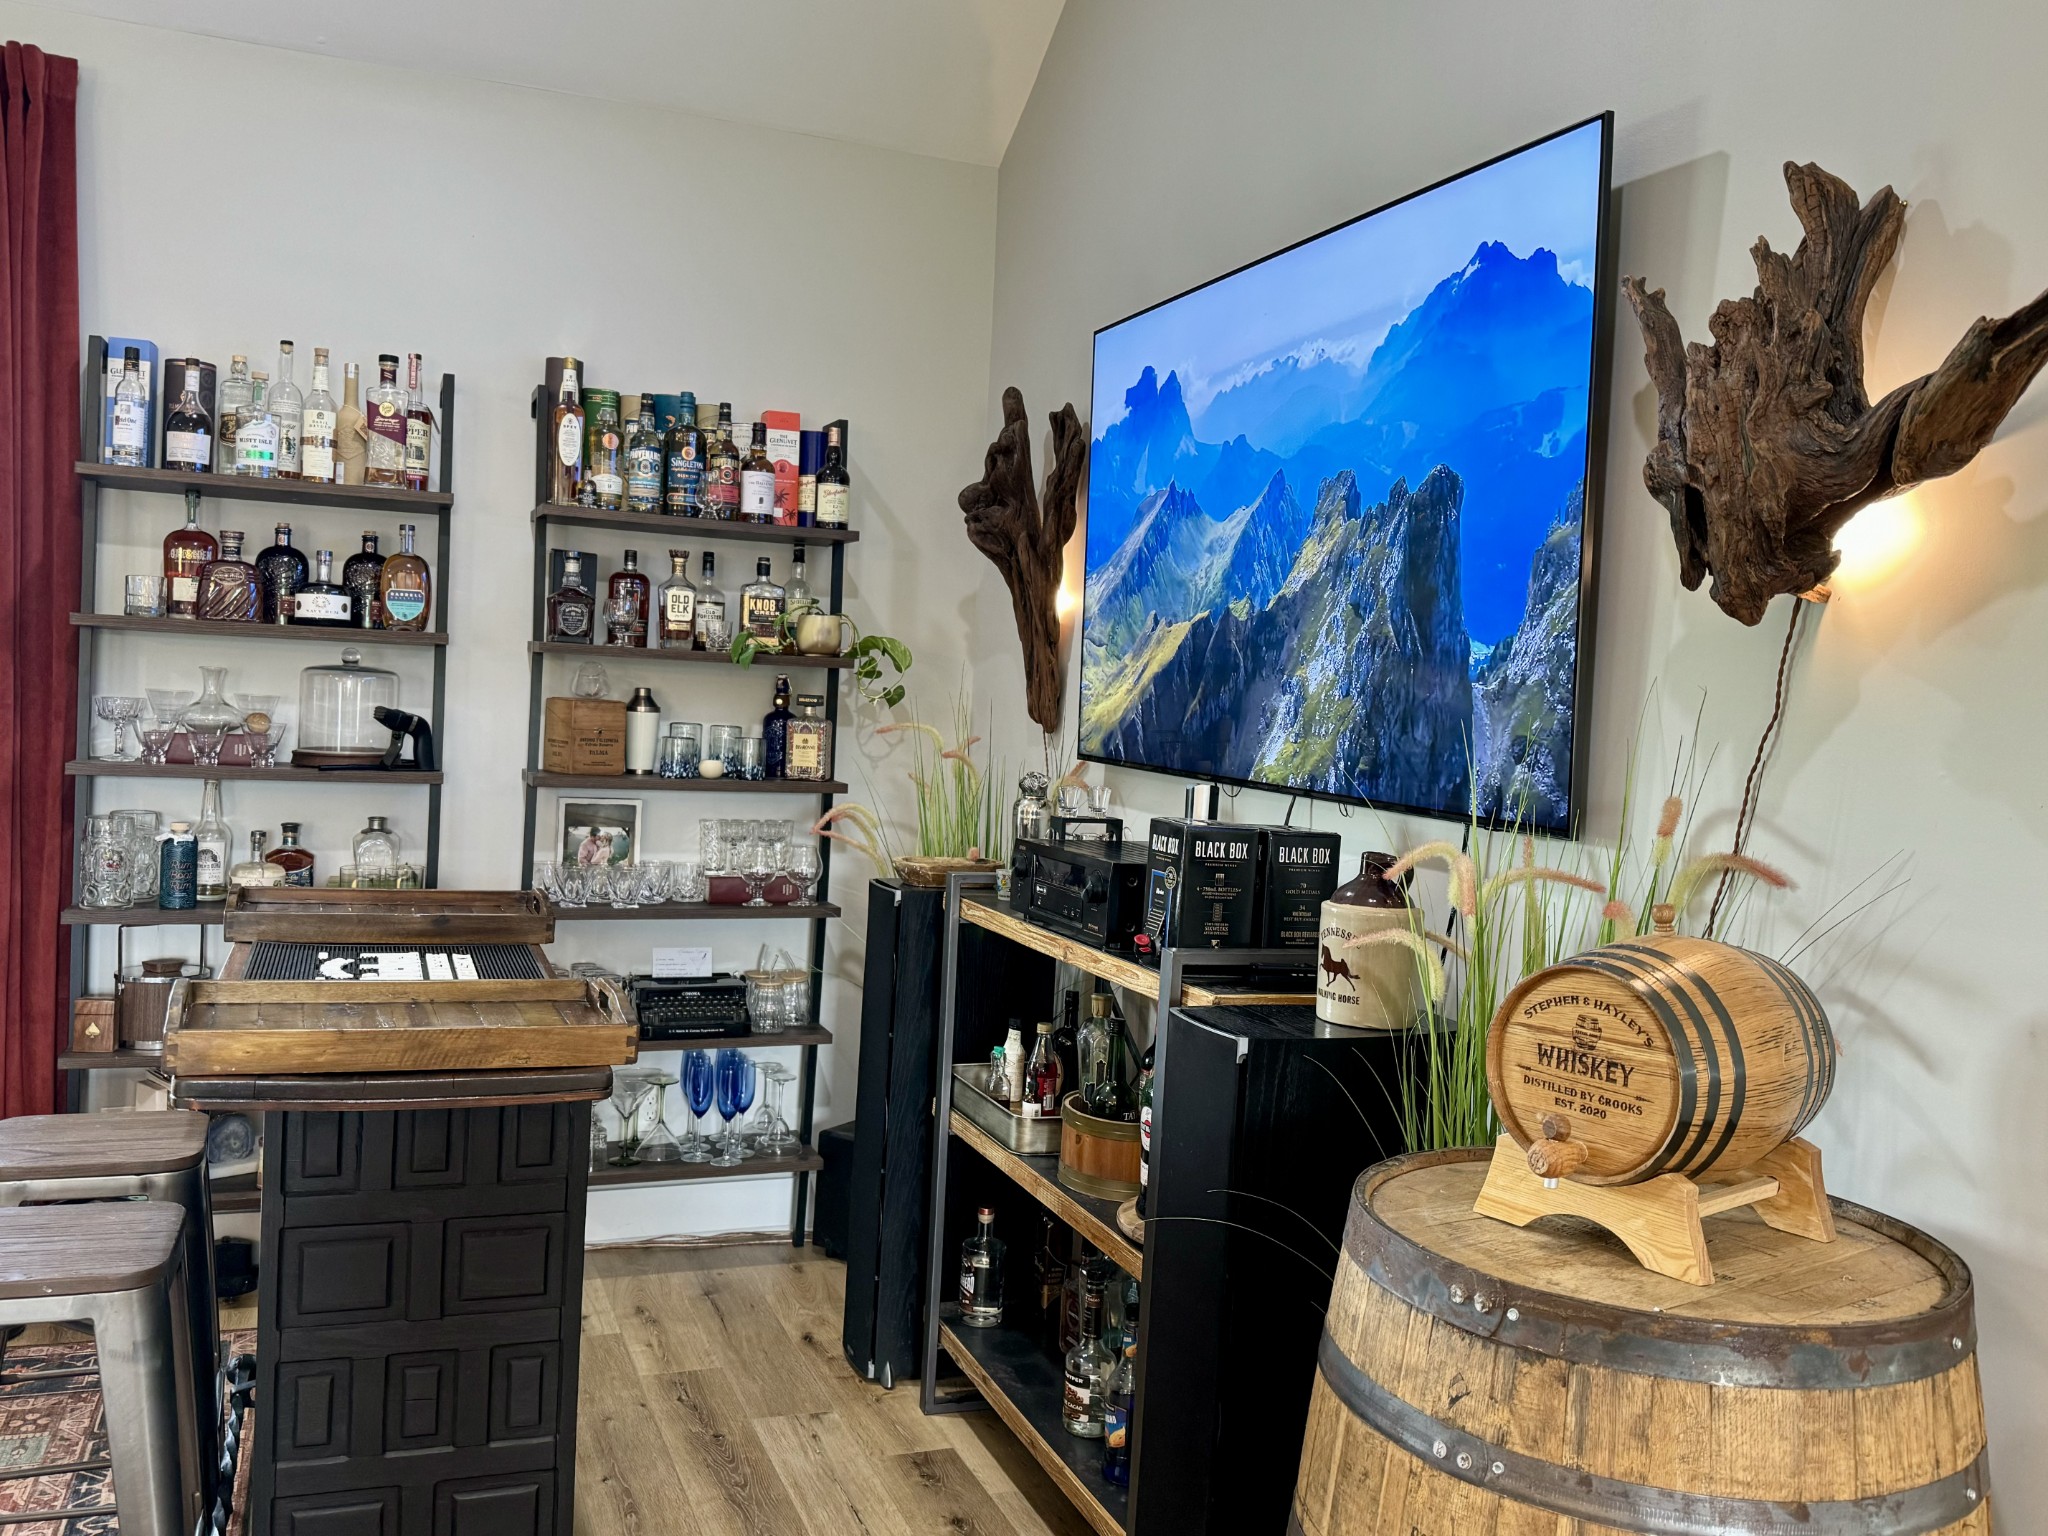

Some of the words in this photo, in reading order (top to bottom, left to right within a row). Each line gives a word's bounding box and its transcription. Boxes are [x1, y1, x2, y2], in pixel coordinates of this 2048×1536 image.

[769, 437, 798, 446] GLENLIVET
[671, 594, 690, 605] OLD
[750, 598, 776, 611] KNOB
[671, 604, 689, 614] ELK
[1152, 834, 1168, 853] BLACK
[1195, 841, 1225, 858] BLACK
[1230, 841, 1248, 859] BOX
[1279, 847, 1308, 863] BLACK
[1313, 848, 1330, 864] BOX
[171, 860, 192, 870] Rum
[170, 881, 192, 890] Rum
[1337, 993, 1360, 1006] HORSE
[1524, 995, 1580, 1019] STEPHEN
[1582, 995, 1590, 1006] &
[1594, 999, 1654, 1048] HAYLEY'S
[1537, 1043, 1635, 1088] WHISKEY
[1523, 1074, 1577, 1098] DISTILLED
[1580, 1090, 1596, 1103] BY
[1554, 1097, 1577, 1112] EST.
[1579, 1103, 1607, 1120] 2020
[1067, 1401, 1084, 1412] CACAO
